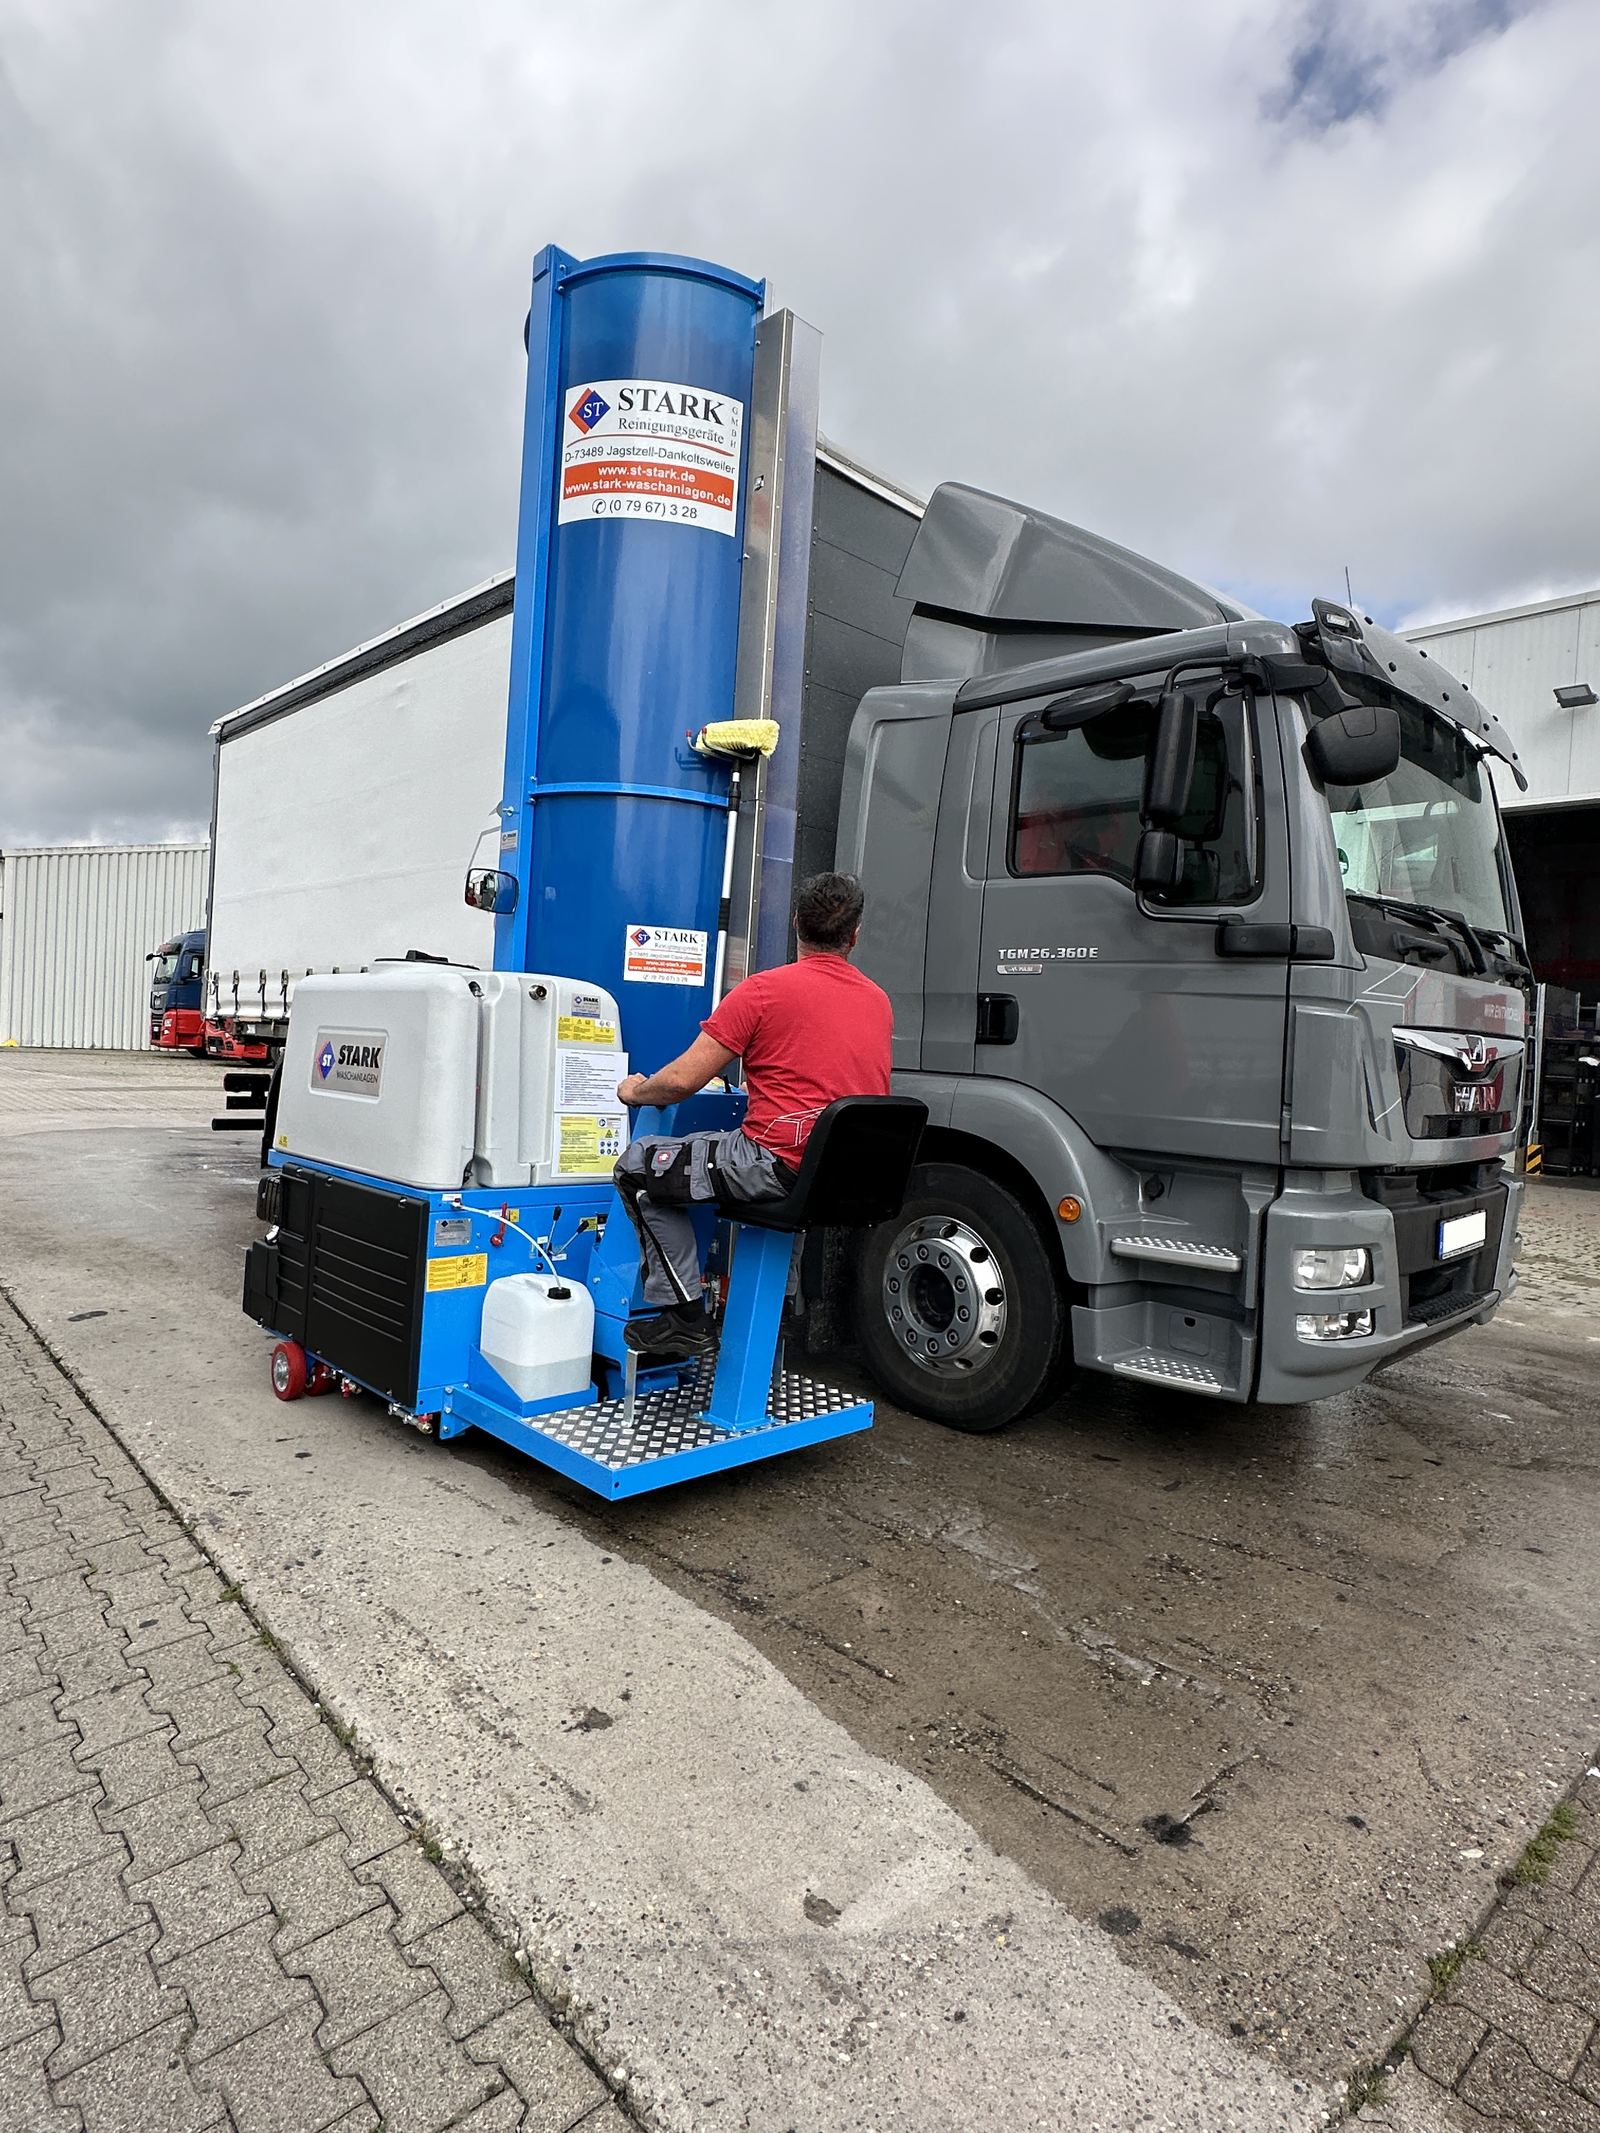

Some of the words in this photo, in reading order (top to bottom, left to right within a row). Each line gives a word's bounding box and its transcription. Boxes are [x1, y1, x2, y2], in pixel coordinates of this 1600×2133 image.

[583, 401, 604, 419] ST
[618, 388, 725, 426] STARK
[618, 417, 725, 444] Reinigungsgeräte
[564, 446, 604, 463] D-73489
[598, 465, 696, 483] www.st-stark.de
[565, 478, 731, 506] www.stark-waschanlagen.de
[626, 500, 641, 512] 79
[645, 501, 666, 517] 67)
[670, 504, 678, 516] 3
[681, 505, 698, 519] 28
[654, 929, 698, 944] STARK
[322, 1054, 332, 1067] ST
[338, 1044, 382, 1069] STARK
[336, 1069, 379, 1083] WASCHANLAGEN
[1453, 1086, 1496, 1112] MAN
